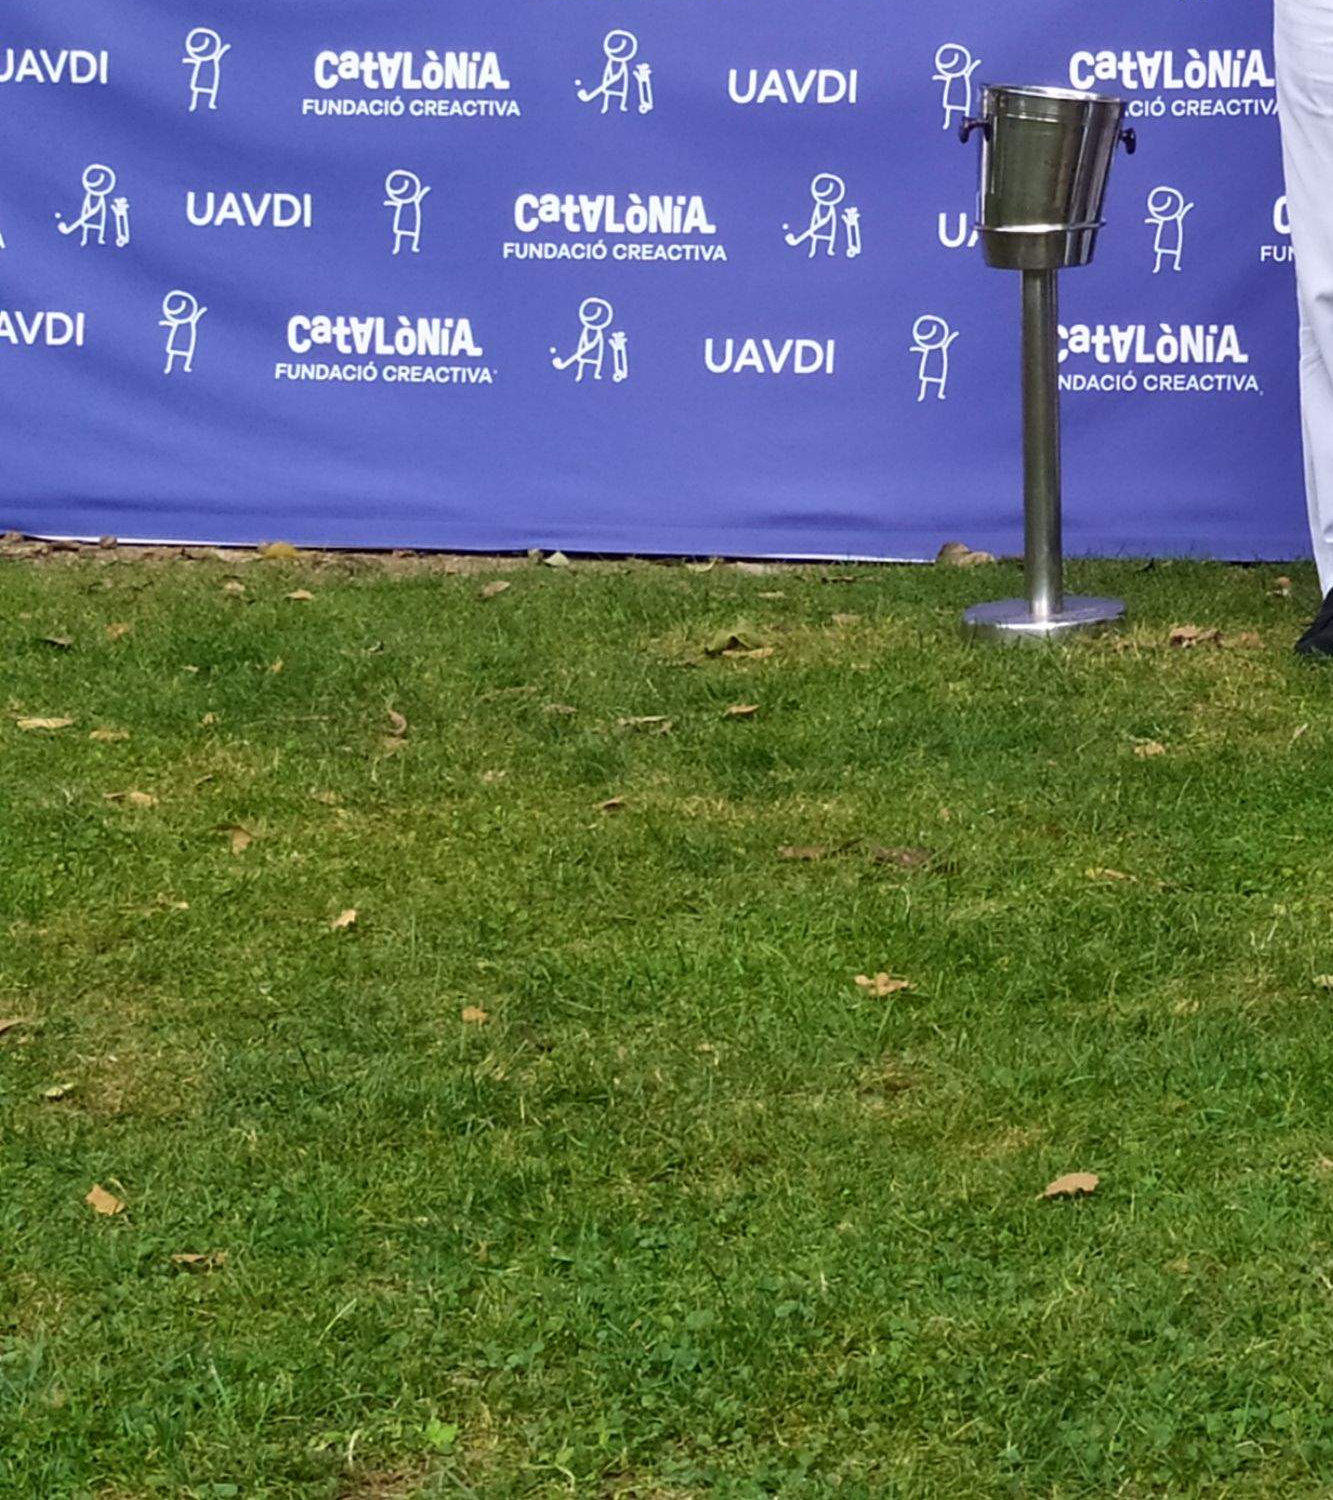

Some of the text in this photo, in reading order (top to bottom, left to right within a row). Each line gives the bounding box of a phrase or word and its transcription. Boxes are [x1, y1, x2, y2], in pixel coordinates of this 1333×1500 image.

[729, 69, 857, 103] UAVDI
[303, 96, 520, 116] FUNDACIÓ CREACTIVA
[187, 192, 311, 227] UAVDI
[504, 240, 727, 260] FUNDACIÓ CREACTIVA
[0, 311, 84, 345] AVDI
[705, 339, 834, 373] UAVDI
[275, 362, 492, 383] FUNDACIÓ CREACTIVA
[1059, 370, 1259, 393] NDACIÓ CREACTIVA
